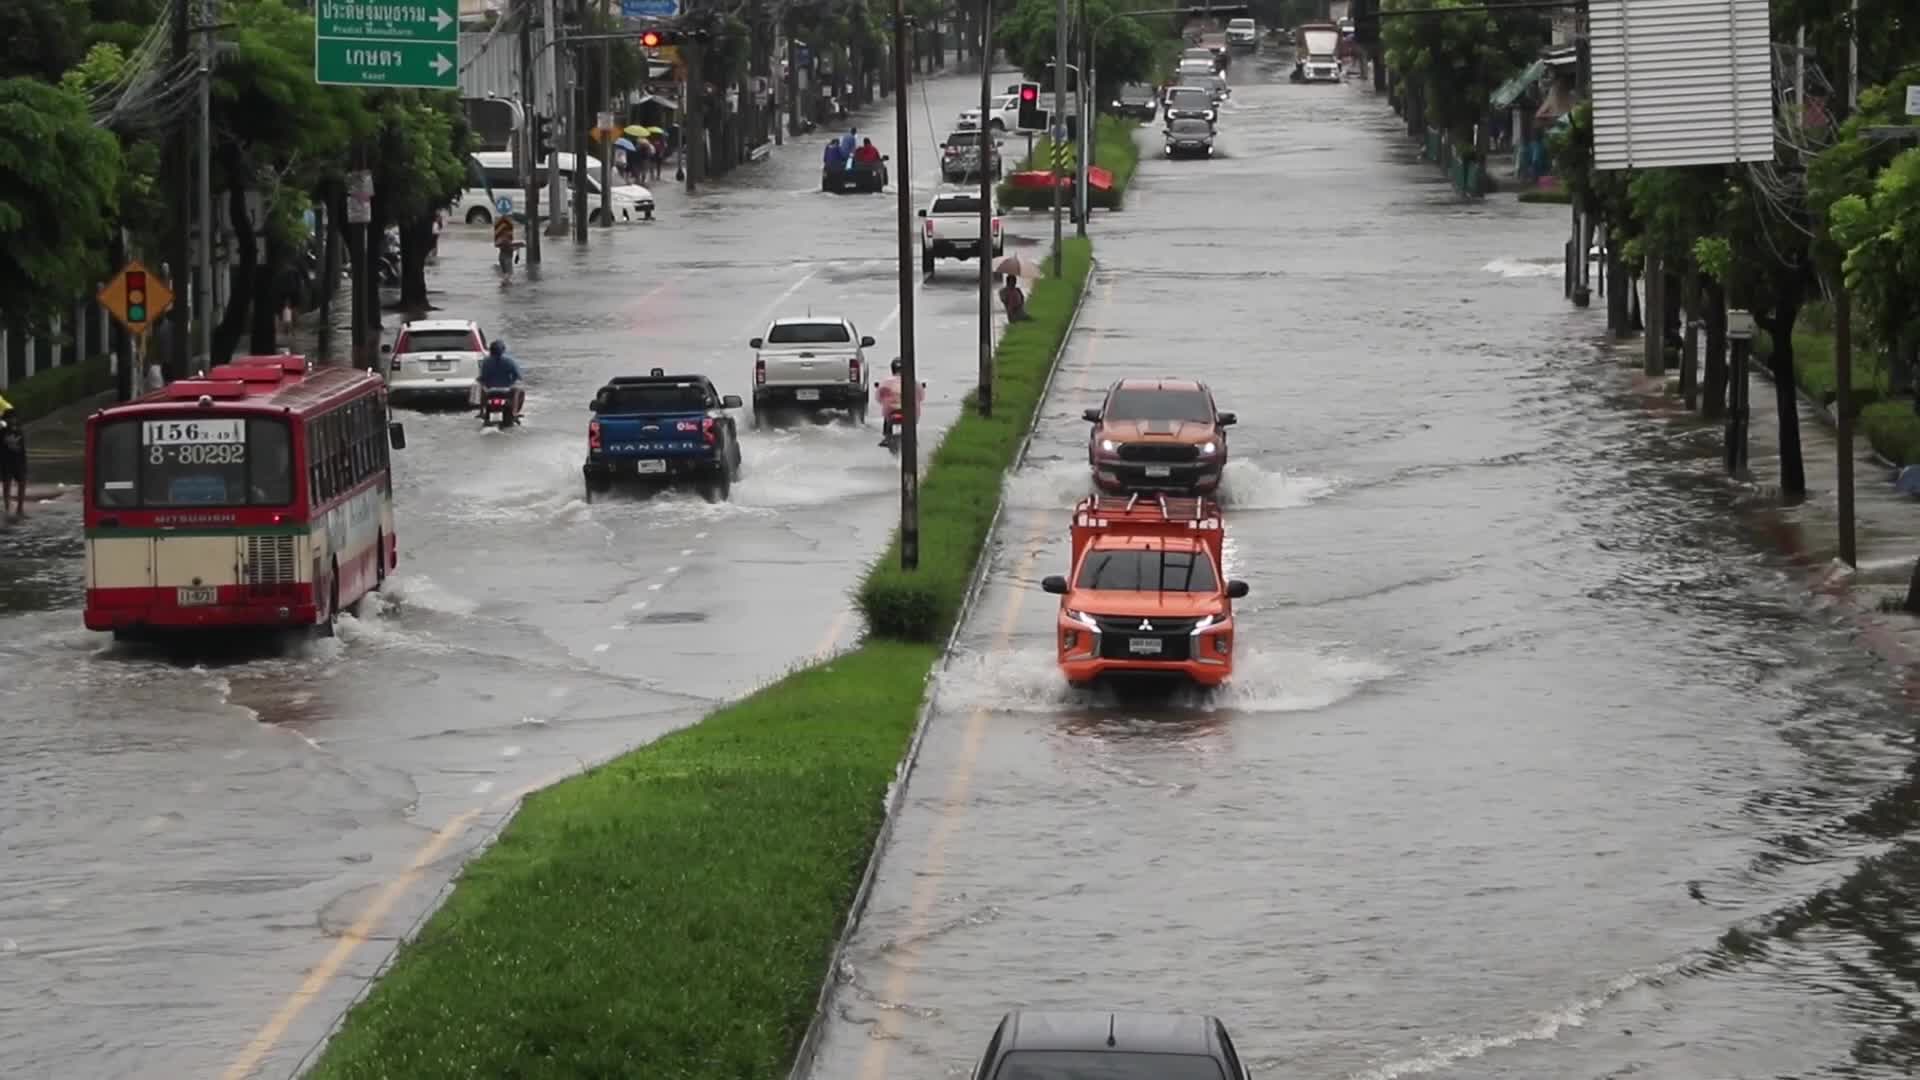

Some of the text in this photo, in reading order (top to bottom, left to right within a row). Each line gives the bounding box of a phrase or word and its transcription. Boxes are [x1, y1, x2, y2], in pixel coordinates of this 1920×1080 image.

[345, 48, 402, 67] เกษตร
[361, 71, 386, 81] Kaset
[157, 423, 199, 441] 156
[609, 442, 694, 452] RANGER
[150, 444, 245, 465] 8-80292
[154, 513, 236, 524] MITSUBISHI
